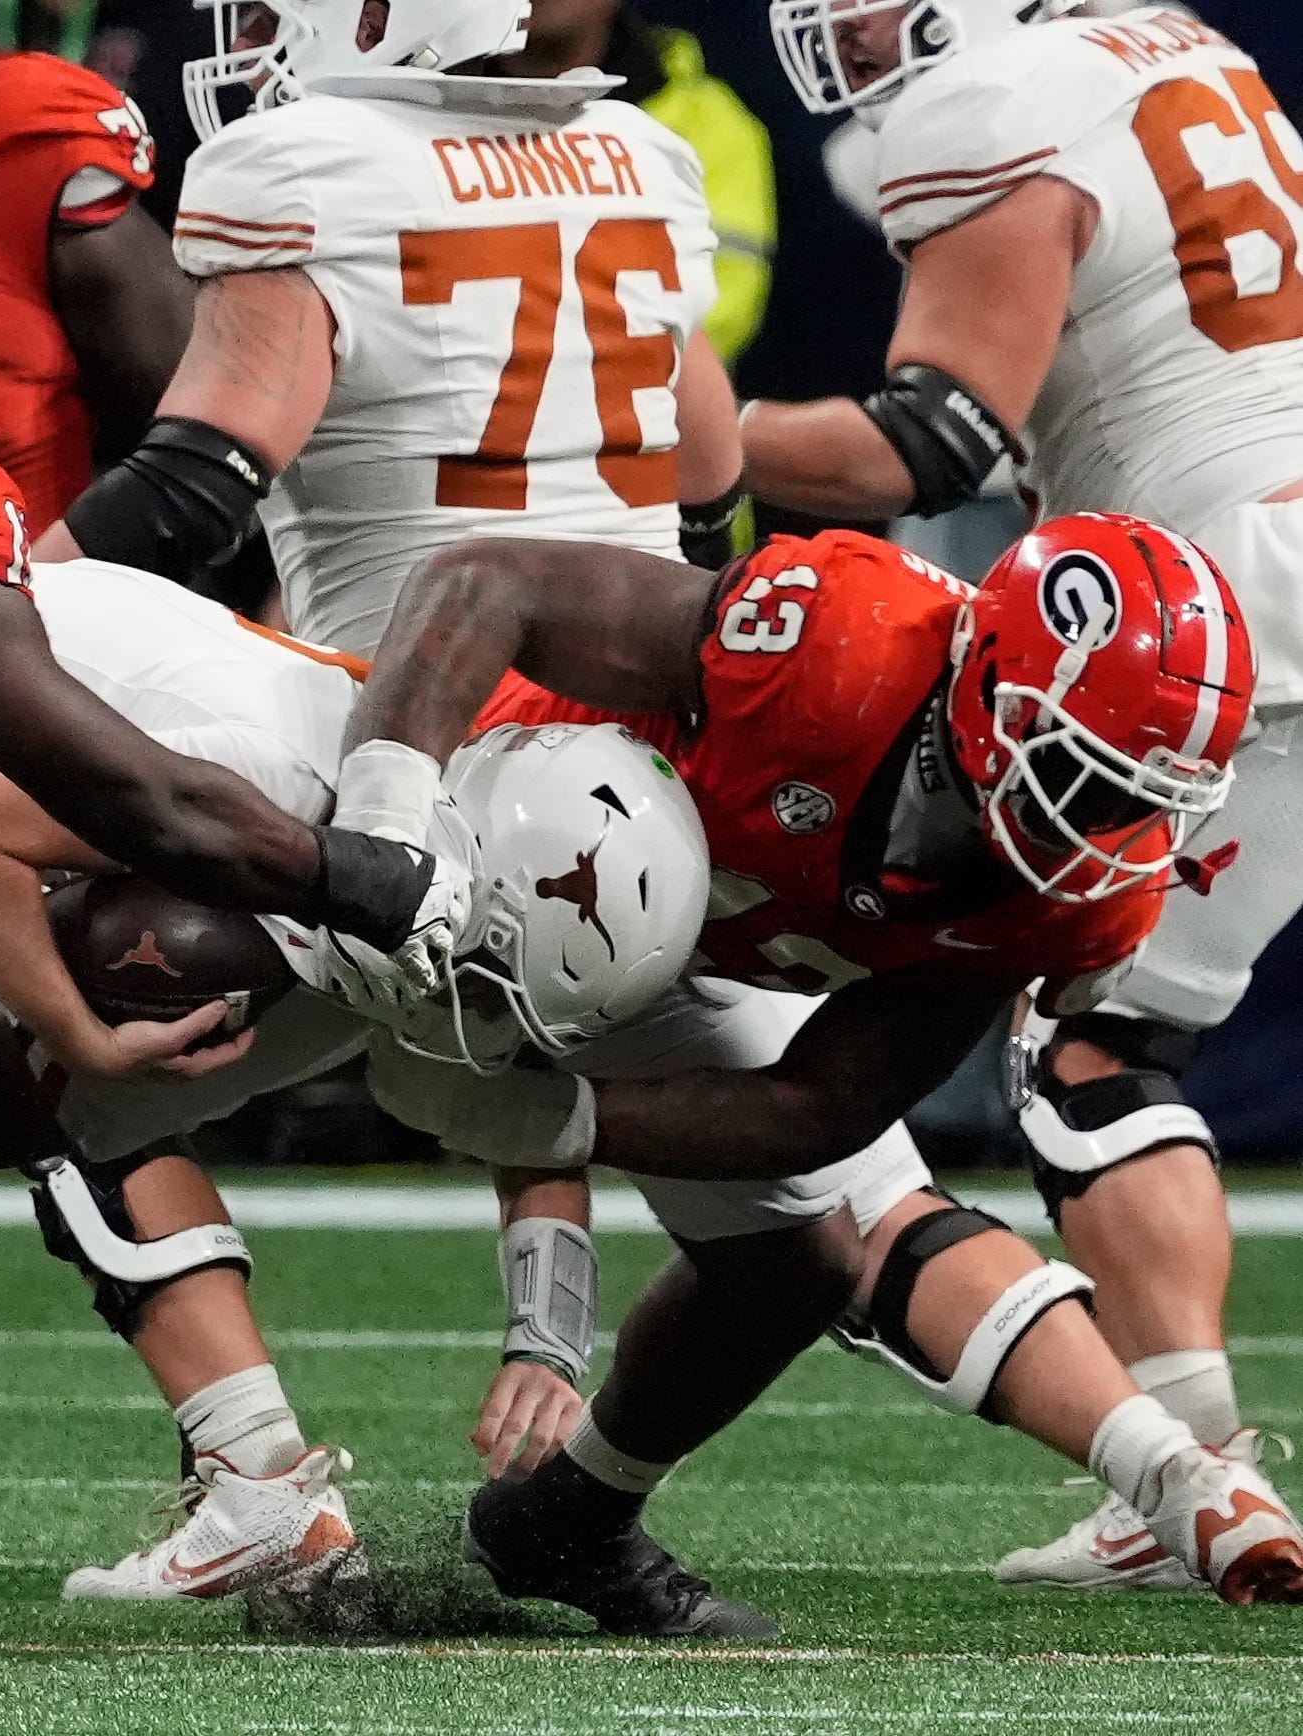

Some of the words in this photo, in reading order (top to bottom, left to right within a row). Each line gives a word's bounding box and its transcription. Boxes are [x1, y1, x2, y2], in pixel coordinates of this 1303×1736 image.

[432, 133, 643, 204] CONNER
[398, 217, 682, 511] 76
[720, 566, 818, 652] 13
